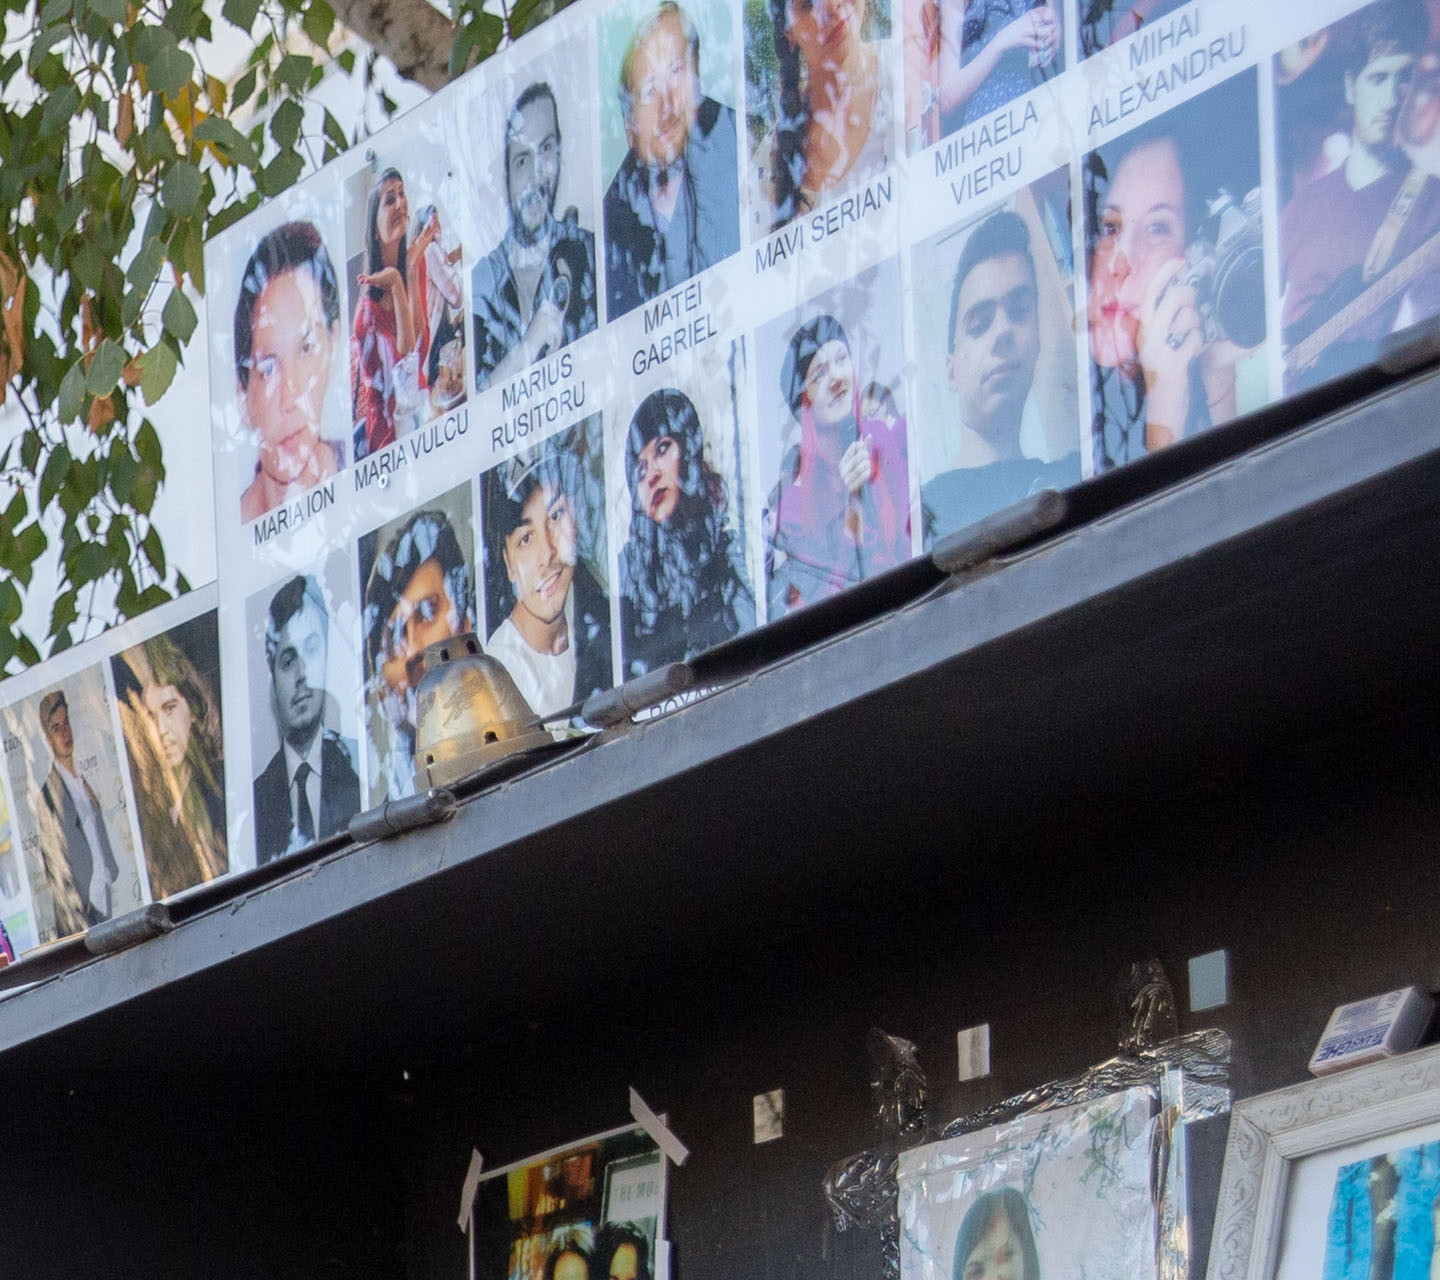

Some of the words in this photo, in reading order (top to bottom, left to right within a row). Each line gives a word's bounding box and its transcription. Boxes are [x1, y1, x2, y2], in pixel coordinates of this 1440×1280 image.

[1128, 7, 1202, 72] MIHAI
[1086, 24, 1247, 137] ALEXANDRU
[933, 99, 1040, 178] MIHAELA
[949, 146, 1025, 208] VIERU
[754, 220, 805, 275] MAVI
[810, 176, 893, 244] SERIAN
[643, 282, 703, 335] MATEI
[631, 319, 719, 377] GABRIEL
[501, 352, 574, 412] MARIUS
[490, 380, 587, 453] RUSITORU
[353, 450, 408, 492] MARIA
[410, 409, 470, 460] VULCU
[253, 507, 305, 547] MARIA
[306, 482, 336, 522] ION
